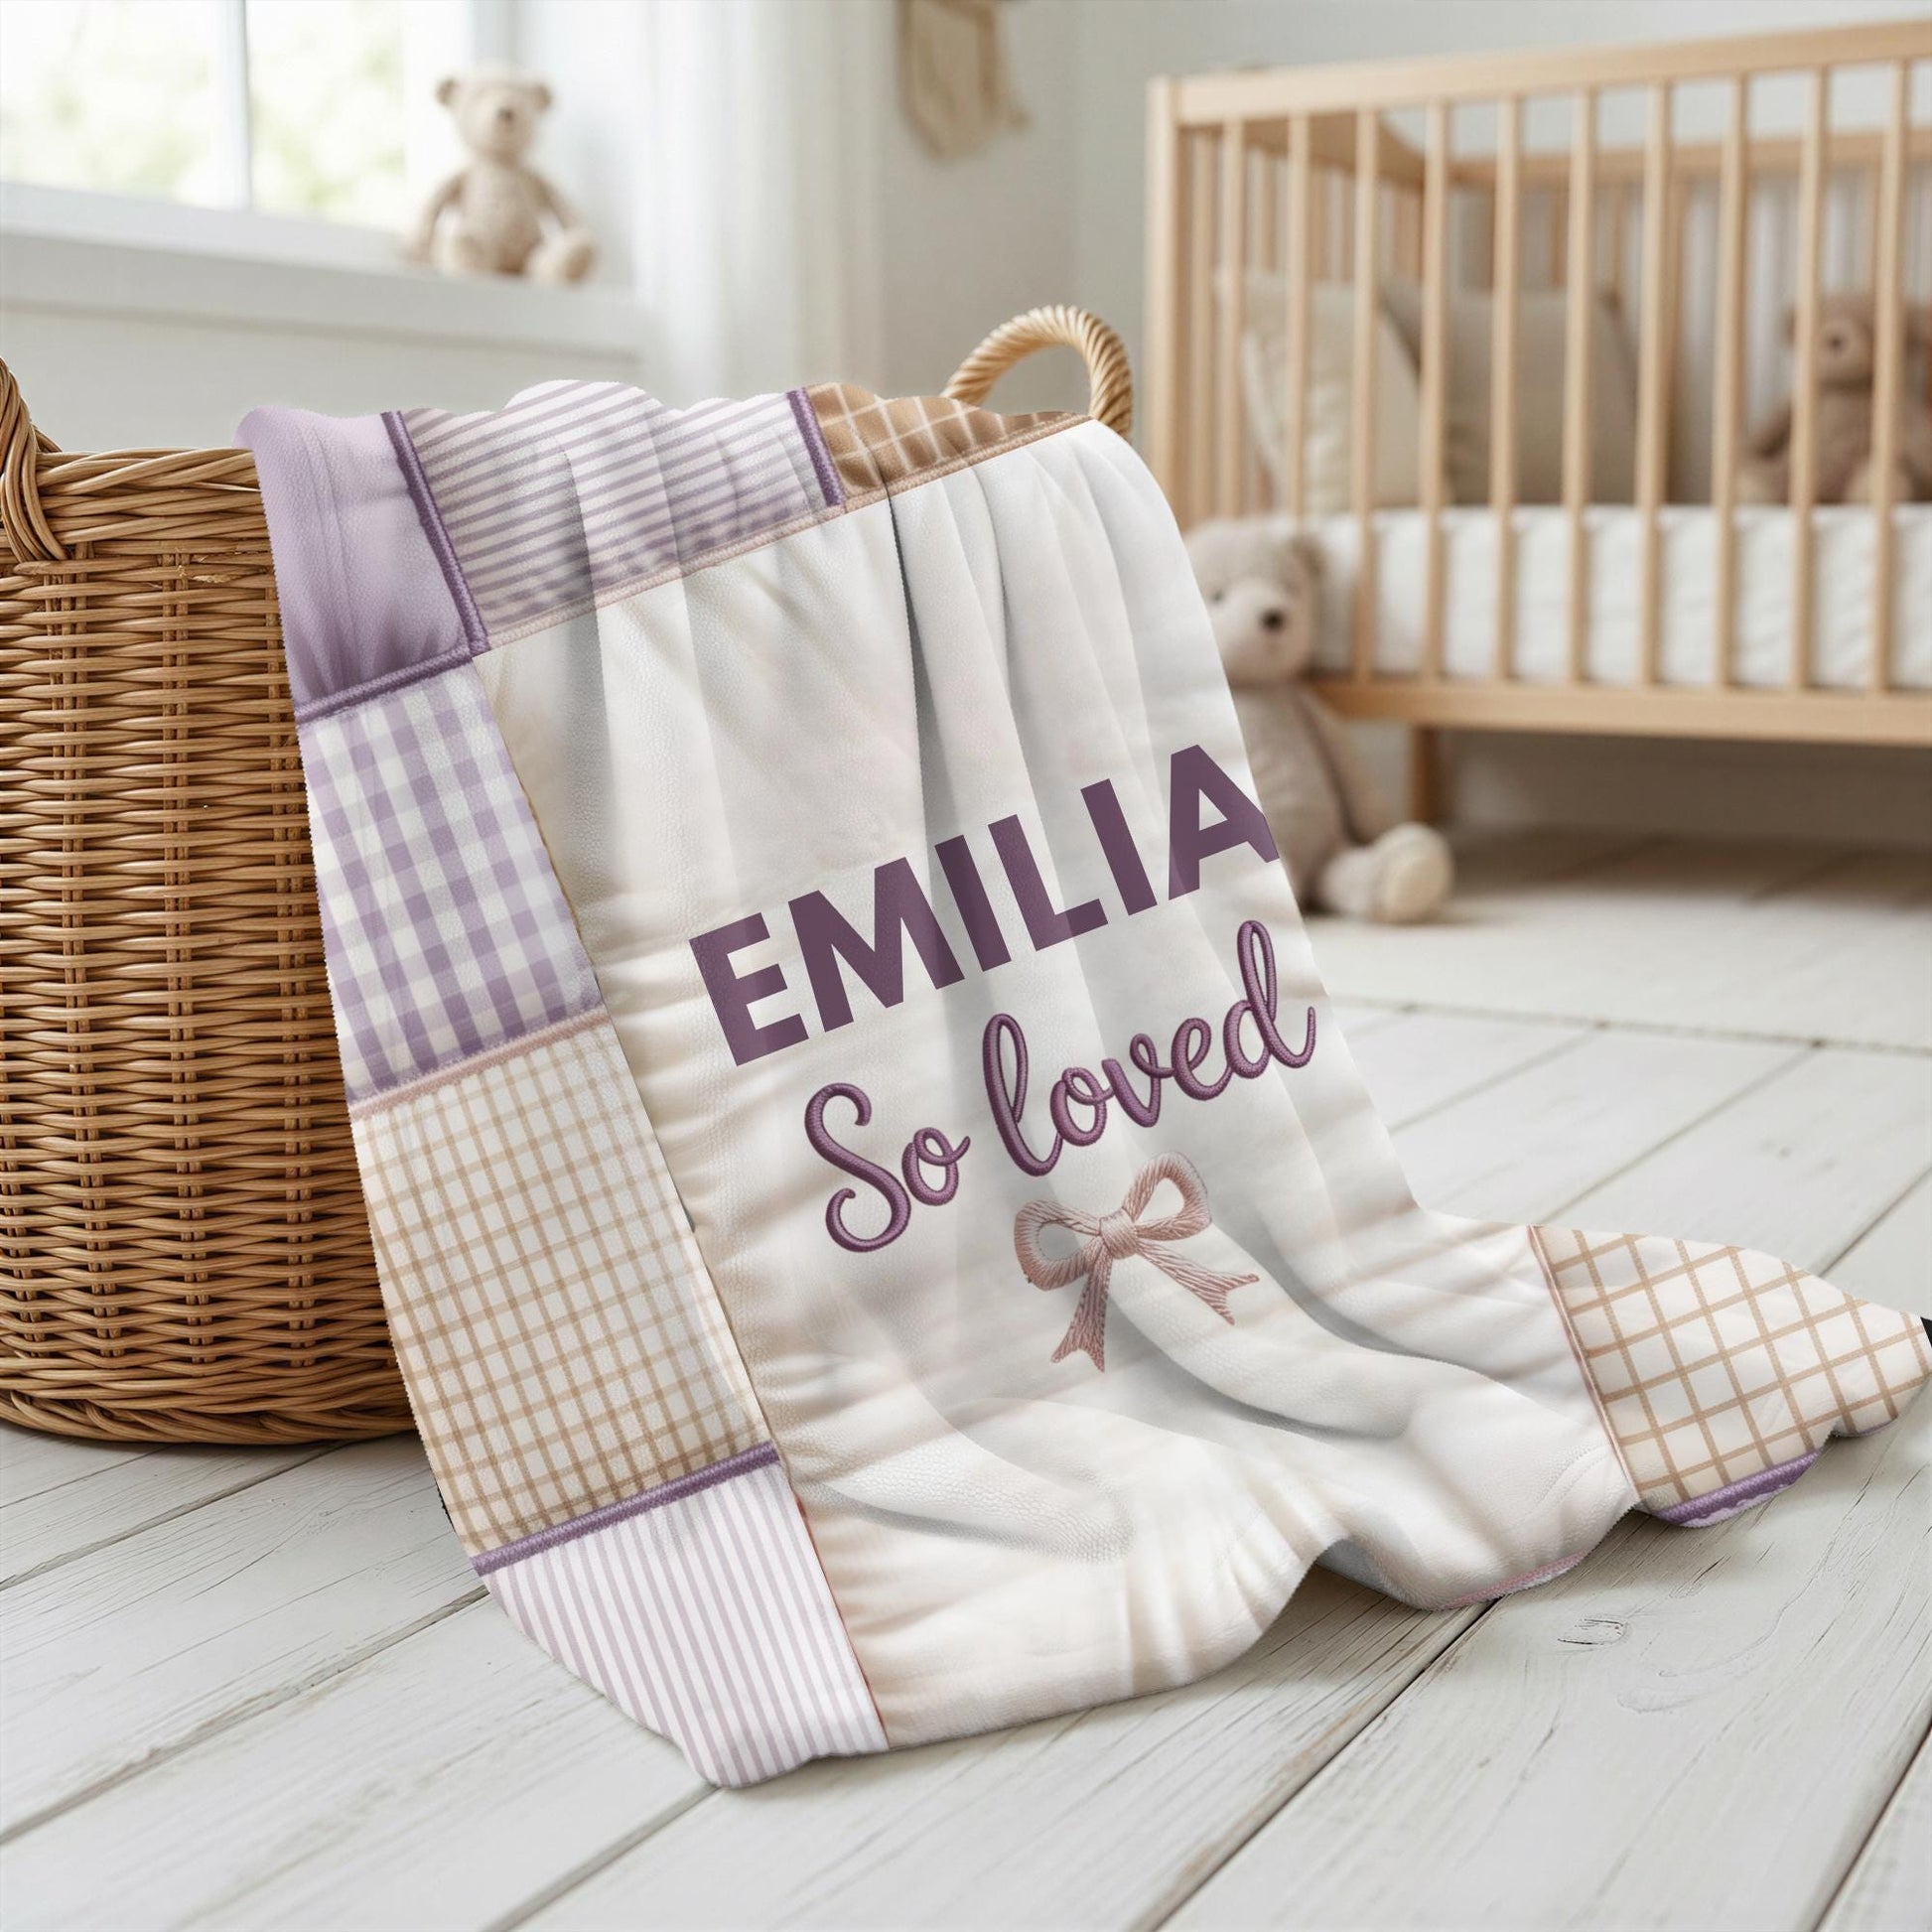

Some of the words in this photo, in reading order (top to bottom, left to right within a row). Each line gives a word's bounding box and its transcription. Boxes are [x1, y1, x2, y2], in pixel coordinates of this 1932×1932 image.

[689, 745, 1279, 1066] EMILIA
[804, 1083, 971, 1252] So
[982, 919, 1315, 1176] loved
